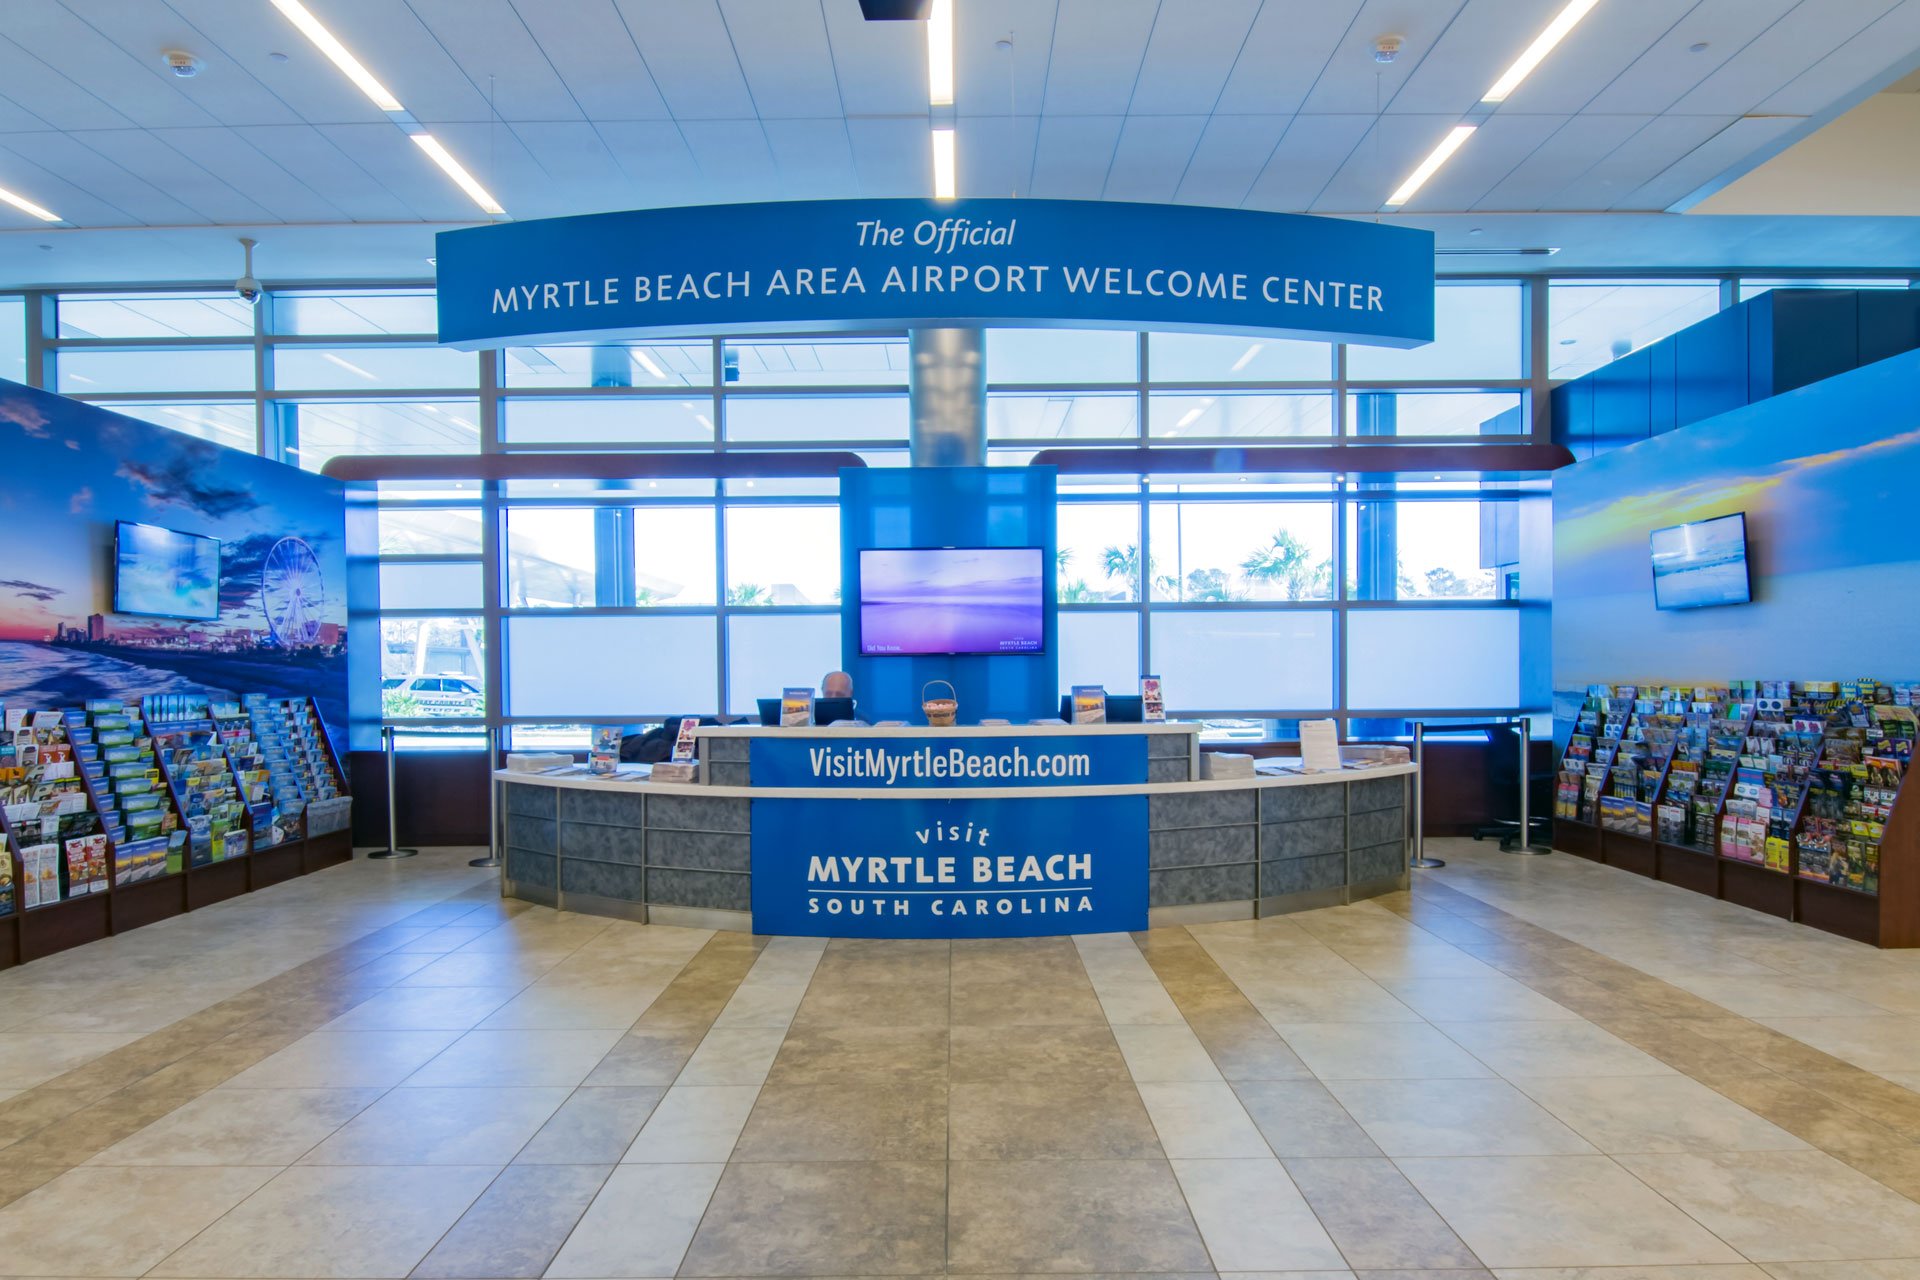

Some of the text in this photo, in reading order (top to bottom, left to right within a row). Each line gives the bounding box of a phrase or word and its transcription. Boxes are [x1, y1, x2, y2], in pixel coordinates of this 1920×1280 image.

[857, 218, 1016, 254] The Official
[492, 265, 1384, 314] MYRTLE BEACH AREA AIRPORT WELCOME CENTER
[809, 746, 1090, 785] VisitMyrtleBeach.com
[915, 820, 990, 847] visit
[807, 853, 1092, 883] MYRTLE BEACH
[808, 895, 1093, 916] SOUTH CAROLINA
